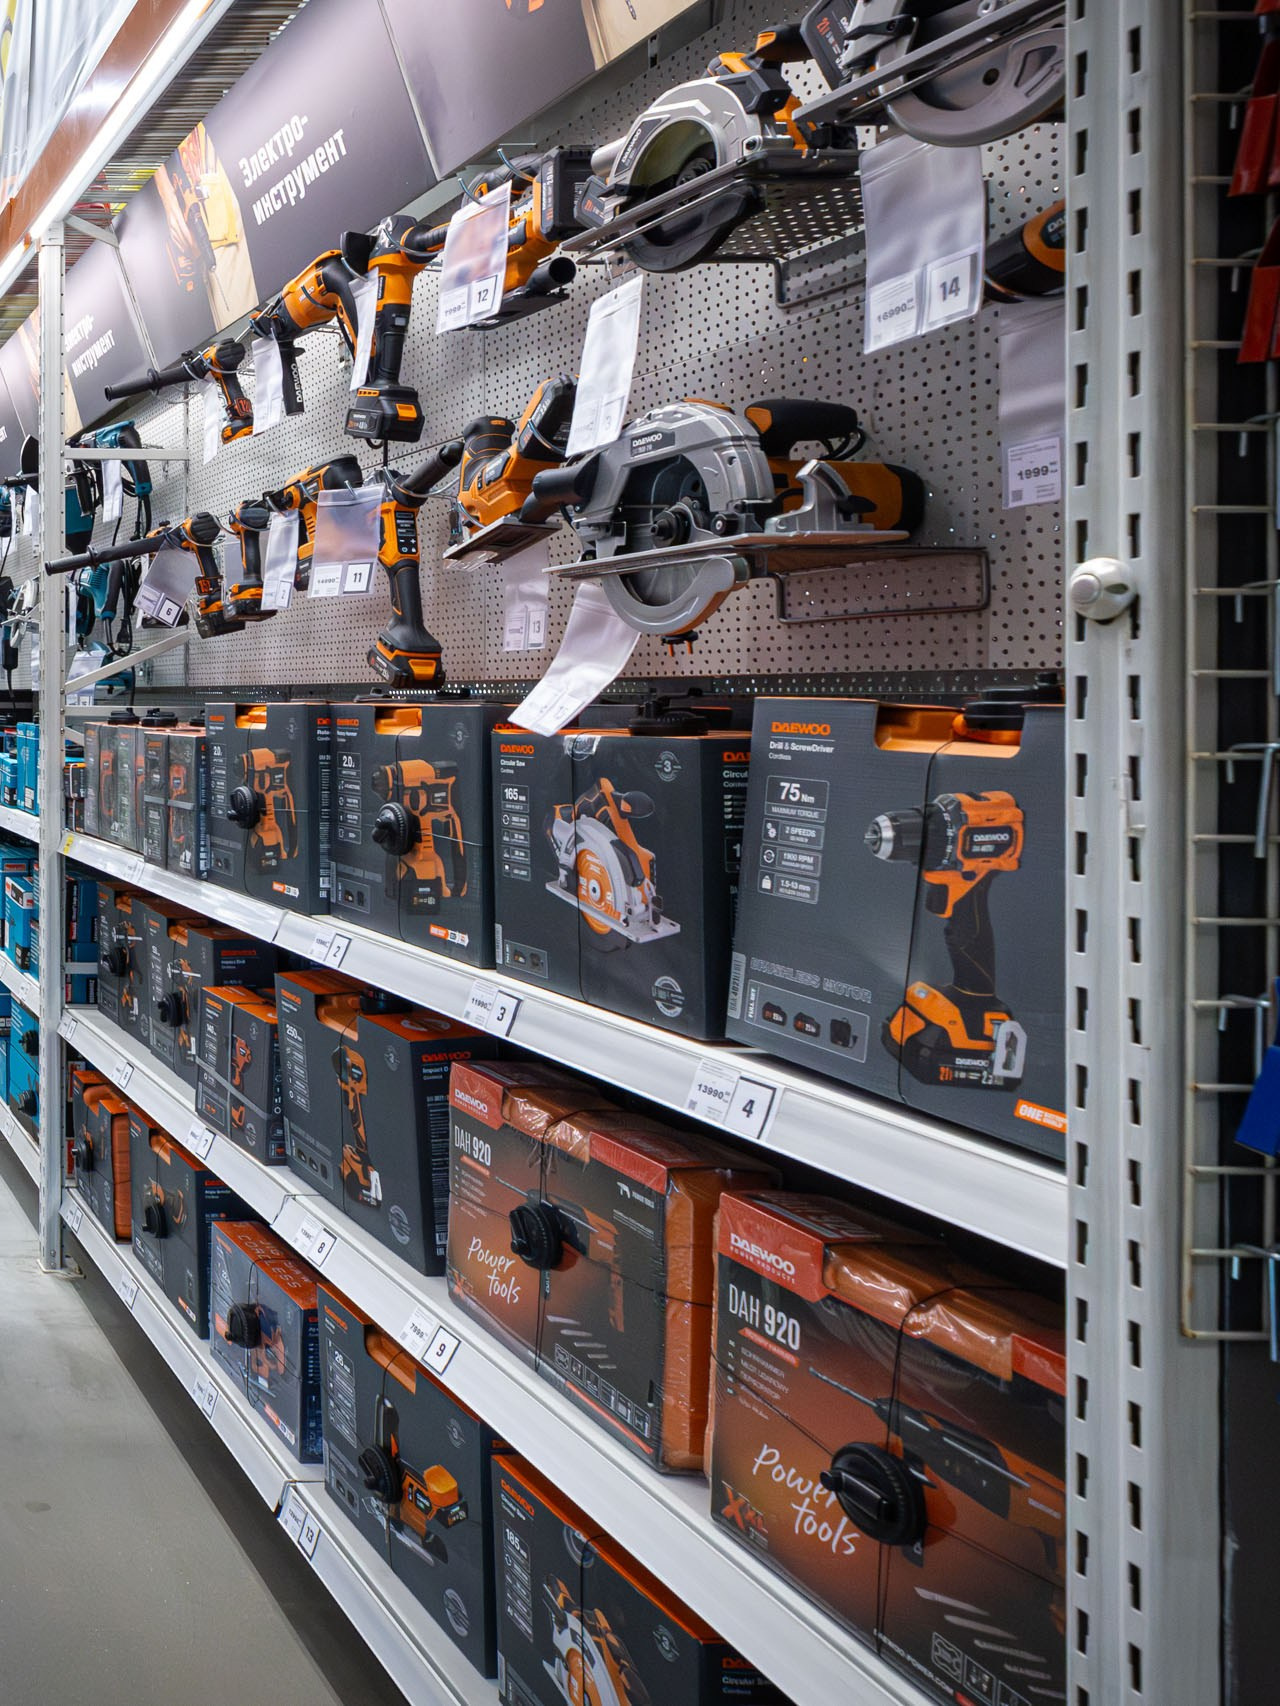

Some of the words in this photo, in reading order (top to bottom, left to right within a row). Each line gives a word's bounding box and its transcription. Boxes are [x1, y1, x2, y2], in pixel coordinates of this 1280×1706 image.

[238, 114, 309, 188] Электро-
[252, 128, 349, 226] инструмент
[477, 288, 489, 303] 12
[939, 276, 961, 303] 14
[71, 329, 115, 378] инструмент
[291, 363, 304, 403] DAEWOO
[632, 433, 663, 448] DAEWOO
[353, 572, 363, 583] 11
[166, 607, 173, 616] 6
[532, 620, 541, 633] 13
[771, 721, 831, 736] DAEWOO
[500, 744, 534, 754] DAEWOO
[769, 741, 784, 750] Drill
[790, 743, 834, 754] ScrewDriver
[663, 760, 671, 772] 3
[504, 787, 518, 801] 165
[779, 781, 801, 802] 75
[801, 793, 815, 804] Nm
[790, 827, 816, 838] SPEEDS
[972, 833, 1010, 842] DAEWOO
[798, 854, 814, 864] RPM
[332, 945, 341, 958] 2
[497, 1006, 506, 1021] 3
[422, 1051, 471, 1062] DAEWOO
[697, 1083, 724, 1100] 13990
[455, 1088, 488, 1113] DAEWOO
[742, 1098, 755, 1118] 4
[1019, 1104, 1043, 1121] ONE
[454, 1125, 471, 1154] DAH
[472, 1136, 491, 1167] 920
[318, 1242, 325, 1254] 8
[467, 1236, 516, 1274] Power
[730, 1232, 796, 1276] DAEWOO
[237, 1233, 302, 1289] CORDLESS
[487, 1269, 521, 1304] tools
[728, 1283, 761, 1328] DAH
[763, 1303, 801, 1351] 920
[436, 1343, 446, 1357] 9
[500, 1479, 534, 1517] DAEWOO
[305, 1525, 314, 1543] 13
[791, 1496, 861, 1556] tools
[505, 1528, 520, 1551] 185
